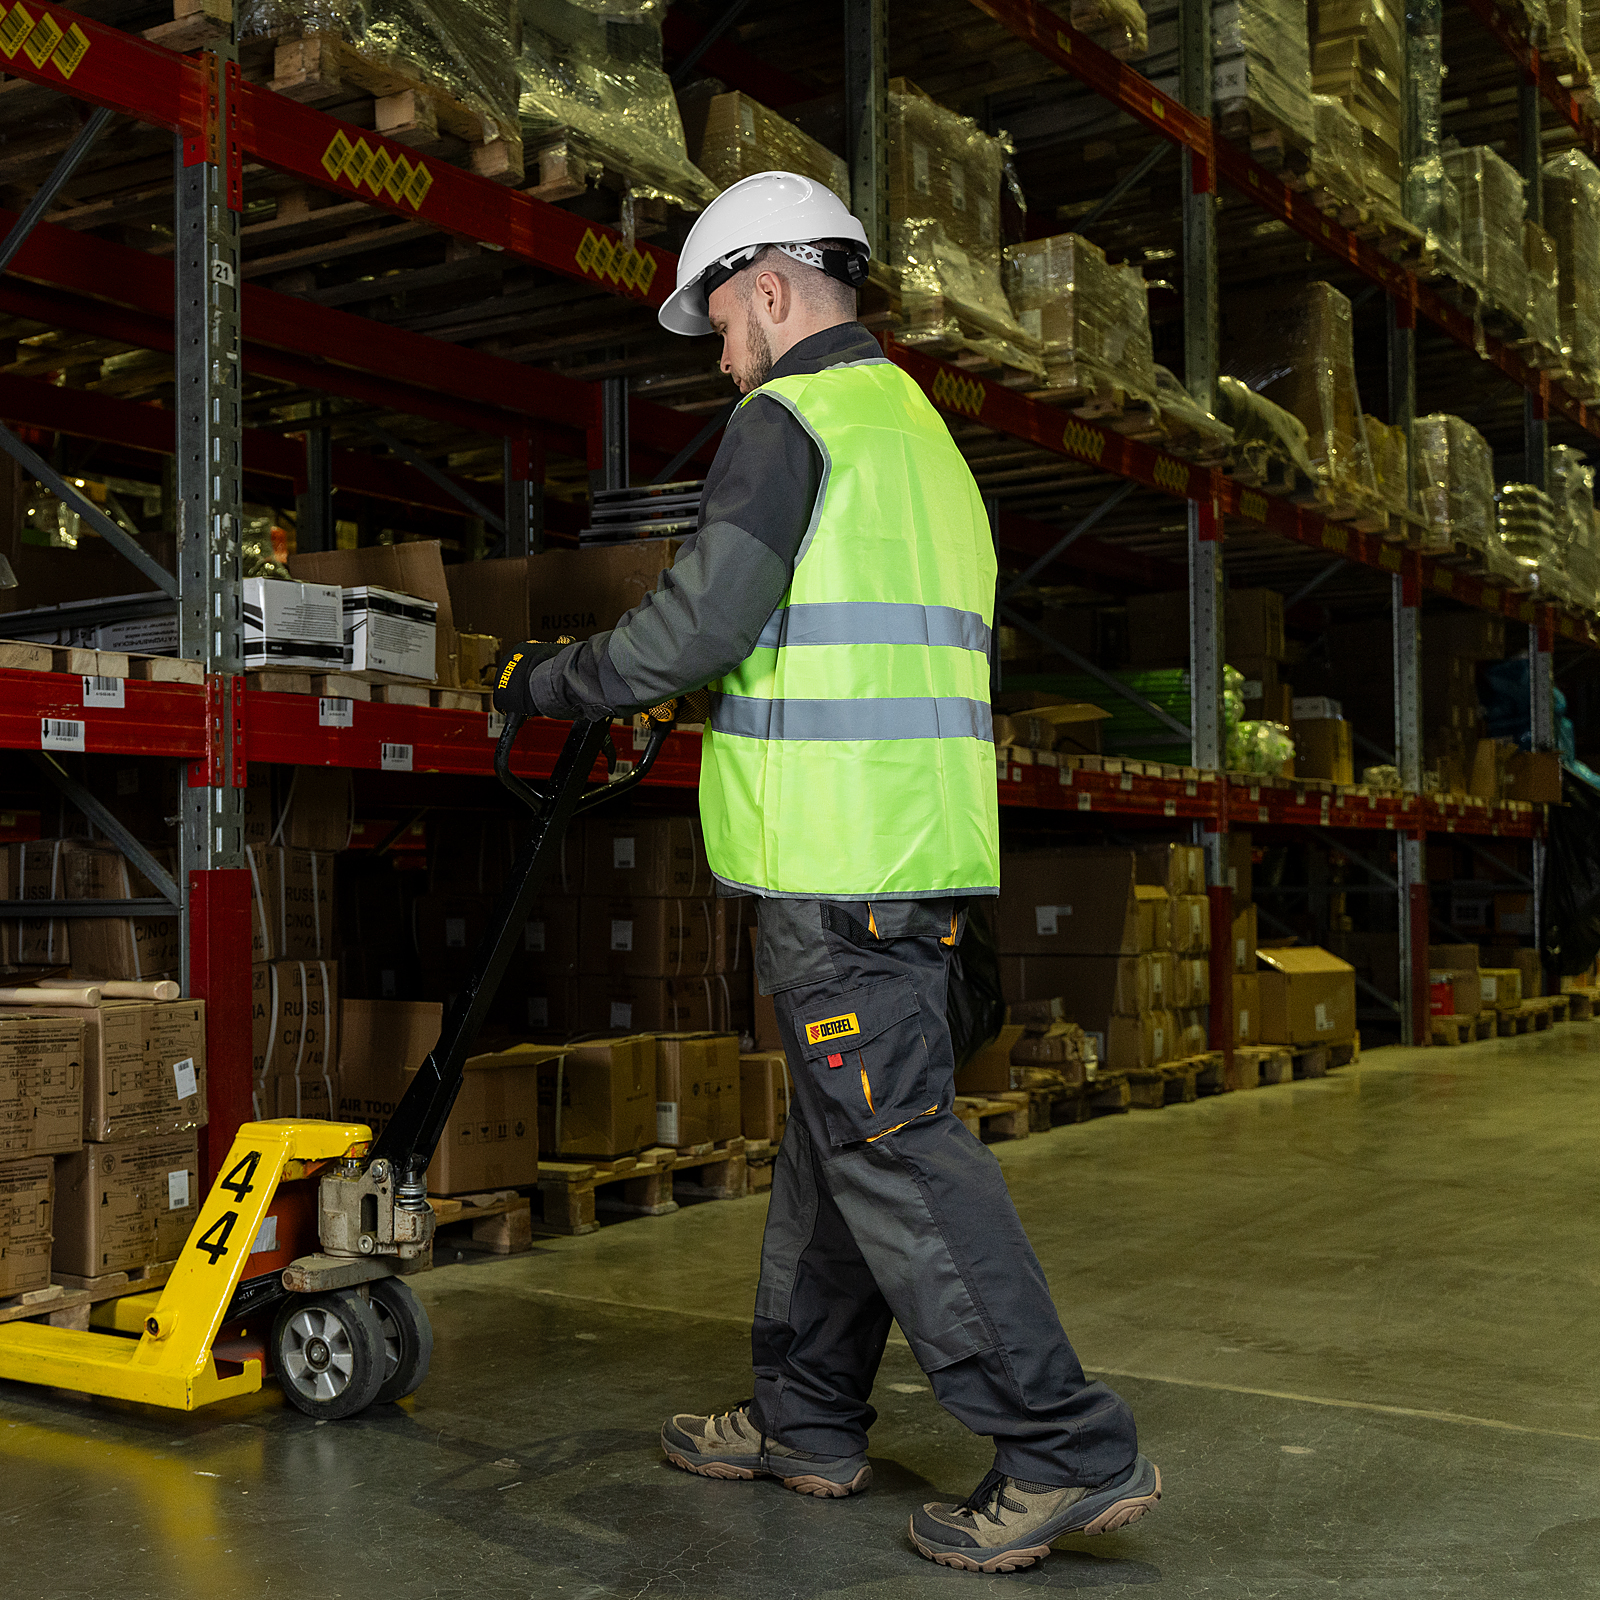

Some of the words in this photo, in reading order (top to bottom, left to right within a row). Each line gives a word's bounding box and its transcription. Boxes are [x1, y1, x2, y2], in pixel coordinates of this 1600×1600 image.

[216, 264, 228, 280] 21
[541, 612, 597, 630] RUSSIA
[498, 660, 517, 690] DENZEL
[285, 886, 328, 902] RUSSA
[135, 921, 173, 942] C/NO:
[284, 1000, 331, 1016] RUSSI
[820, 1018, 854, 1037] DENZEL
[339, 1098, 361, 1112] AIR
